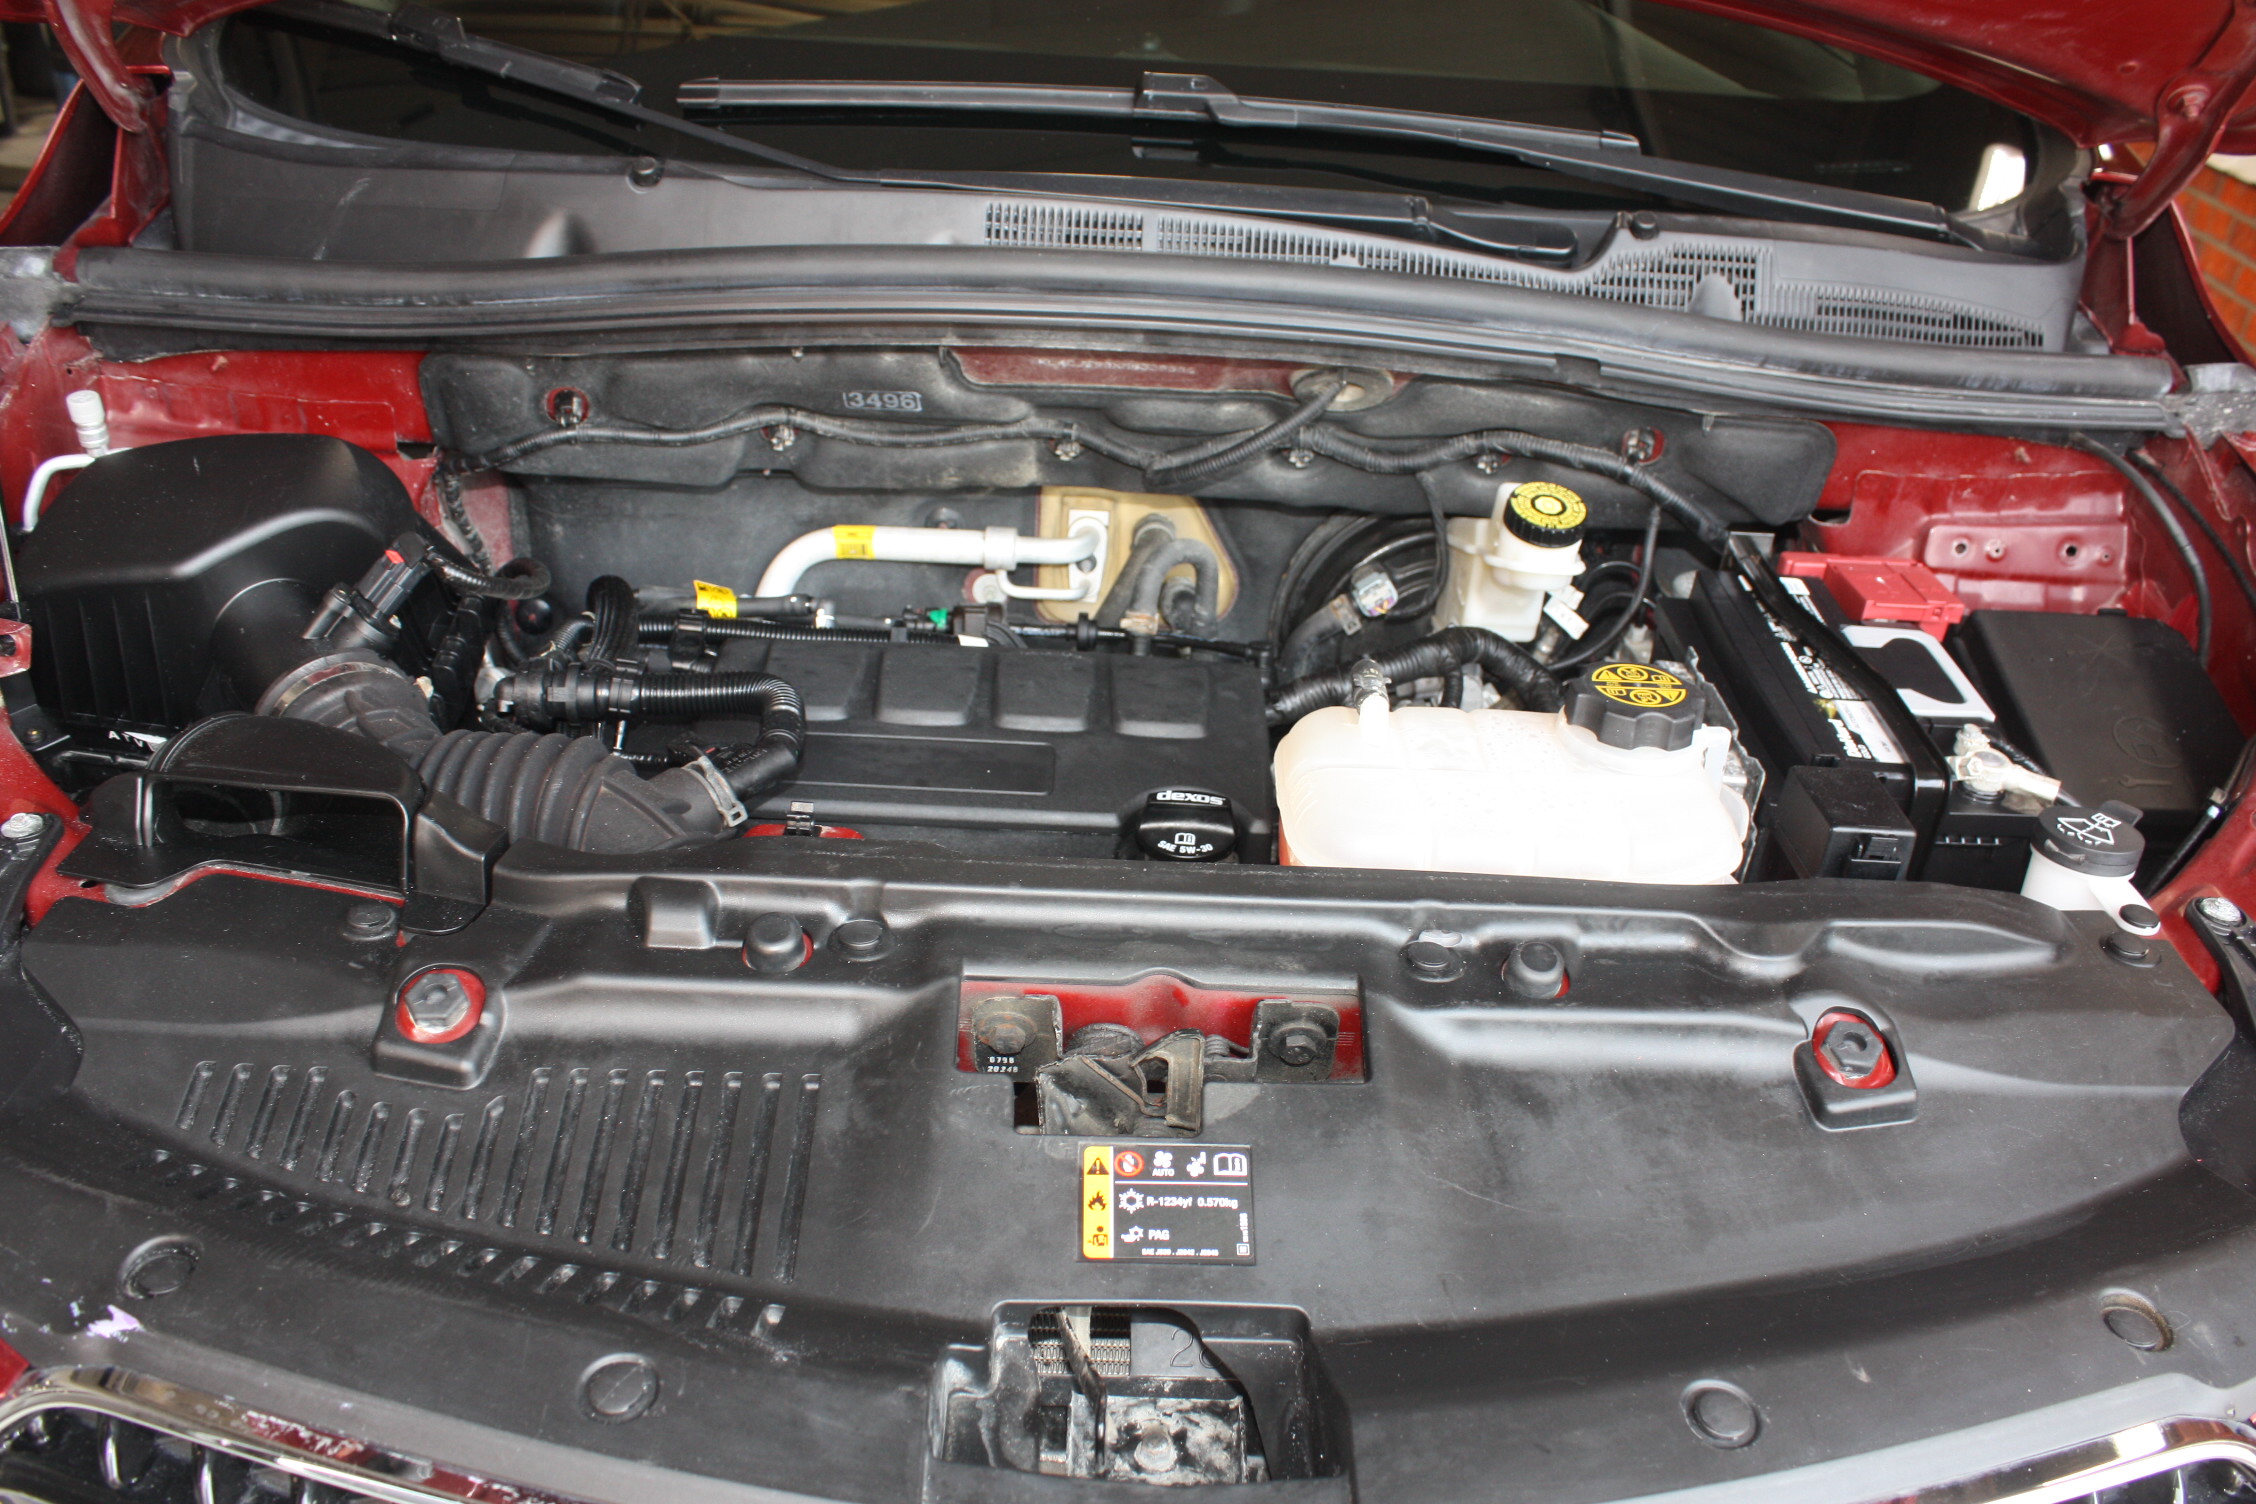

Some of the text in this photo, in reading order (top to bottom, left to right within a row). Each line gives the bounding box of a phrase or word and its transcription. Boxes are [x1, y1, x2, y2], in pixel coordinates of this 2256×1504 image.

[848, 391, 916, 409] 3496
[1156, 790, 1224, 805] dexos
[1157, 840, 1214, 854] SAE 5W-30
[1152, 1168, 1175, 1177] AUTO
[1146, 1196, 1238, 1209] R-1234yf 0.570kg
[1148, 1229, 1170, 1241] PAG
